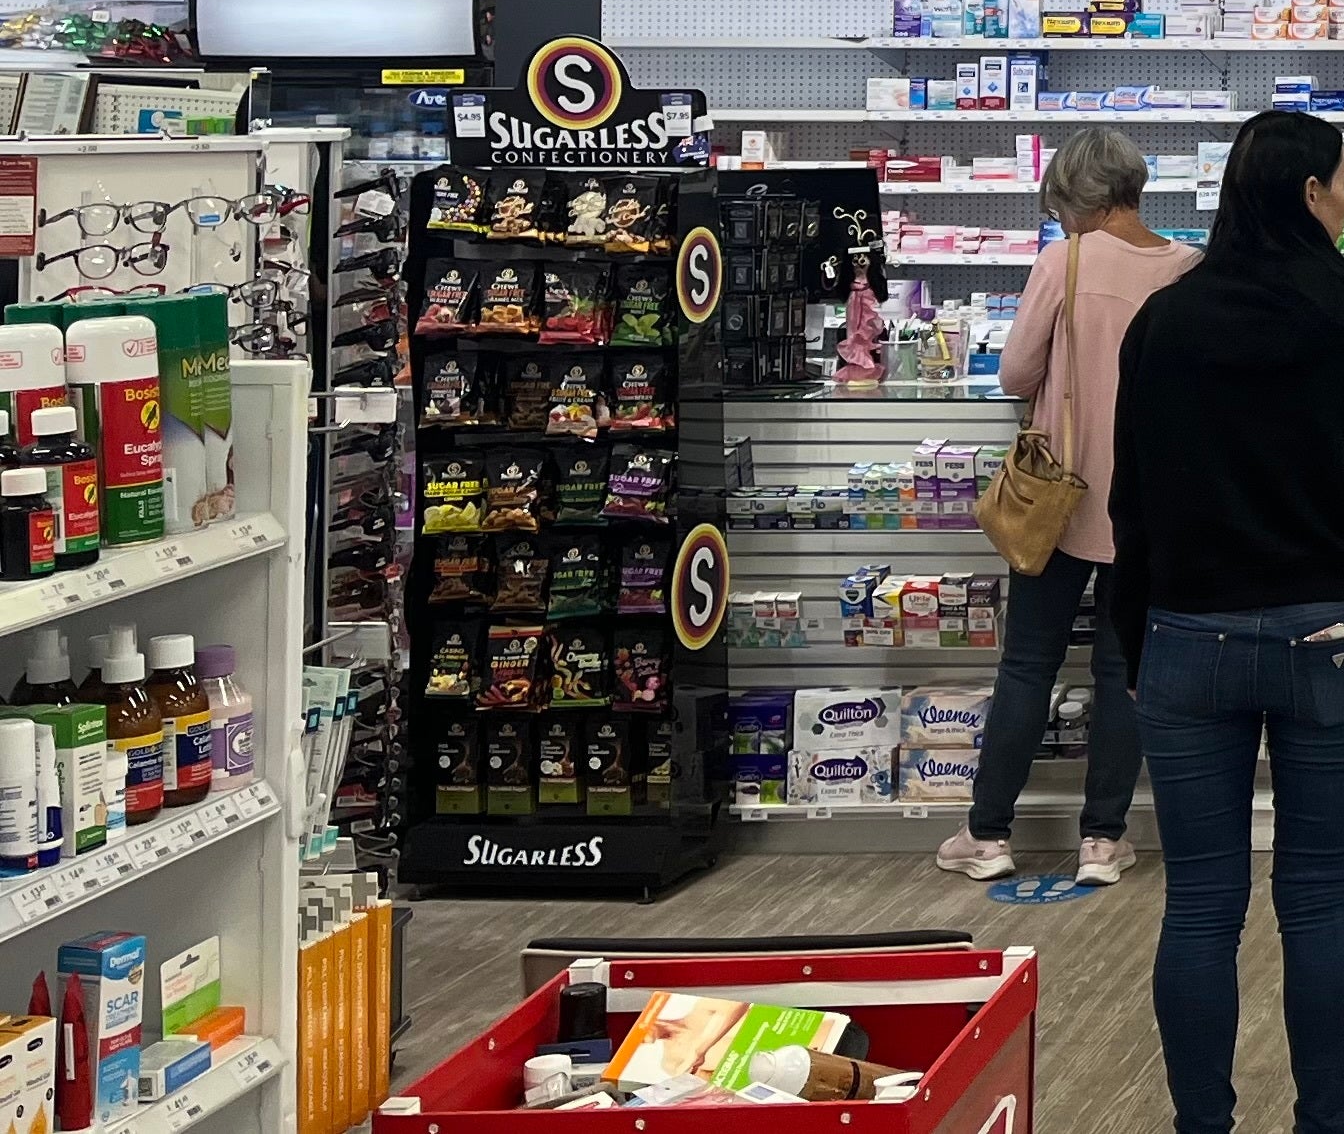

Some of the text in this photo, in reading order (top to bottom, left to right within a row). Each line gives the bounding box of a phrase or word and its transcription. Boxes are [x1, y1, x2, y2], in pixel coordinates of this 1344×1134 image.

[554, 55, 596, 113] S
[489, 112, 668, 149] SUGARLESS
[492, 152, 668, 163] CONFECTIONERY
[689, 244, 710, 304] S
[689, 546, 714, 626] S
[822, 707, 872, 720] Quilton
[918, 706, 981, 727] Kleenex
[814, 765, 863, 777] Quilton
[917, 760, 978, 780] Kleenex
[464, 835, 602, 866] SUGARLESS
[106, 991, 138, 1013] SCAR
